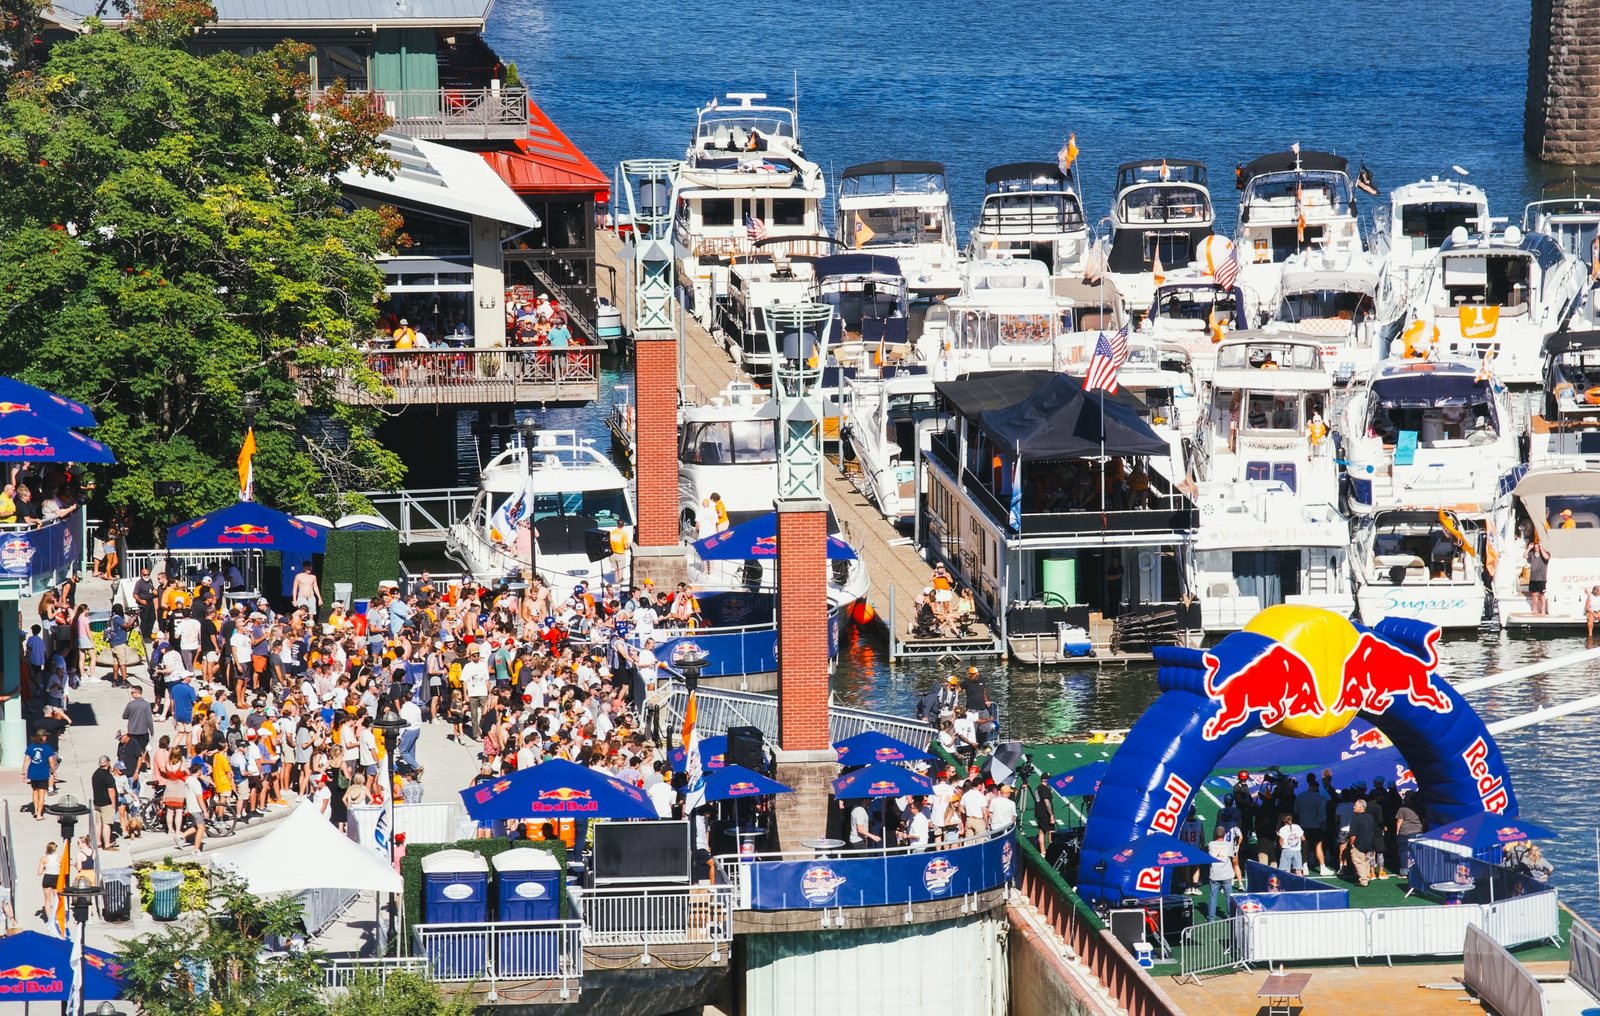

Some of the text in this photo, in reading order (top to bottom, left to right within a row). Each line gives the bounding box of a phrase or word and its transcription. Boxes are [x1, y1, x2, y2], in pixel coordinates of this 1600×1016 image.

[0, 447, 55, 456] ed Bull
[217, 535, 274, 544] Red Bull
[752, 546, 777, 554] Red
[1462, 736, 1502, 797] Red
[532, 801, 598, 812] Red Bull
[1151, 773, 1192, 836] Bull
[0, 980, 63, 993] ed Bull
